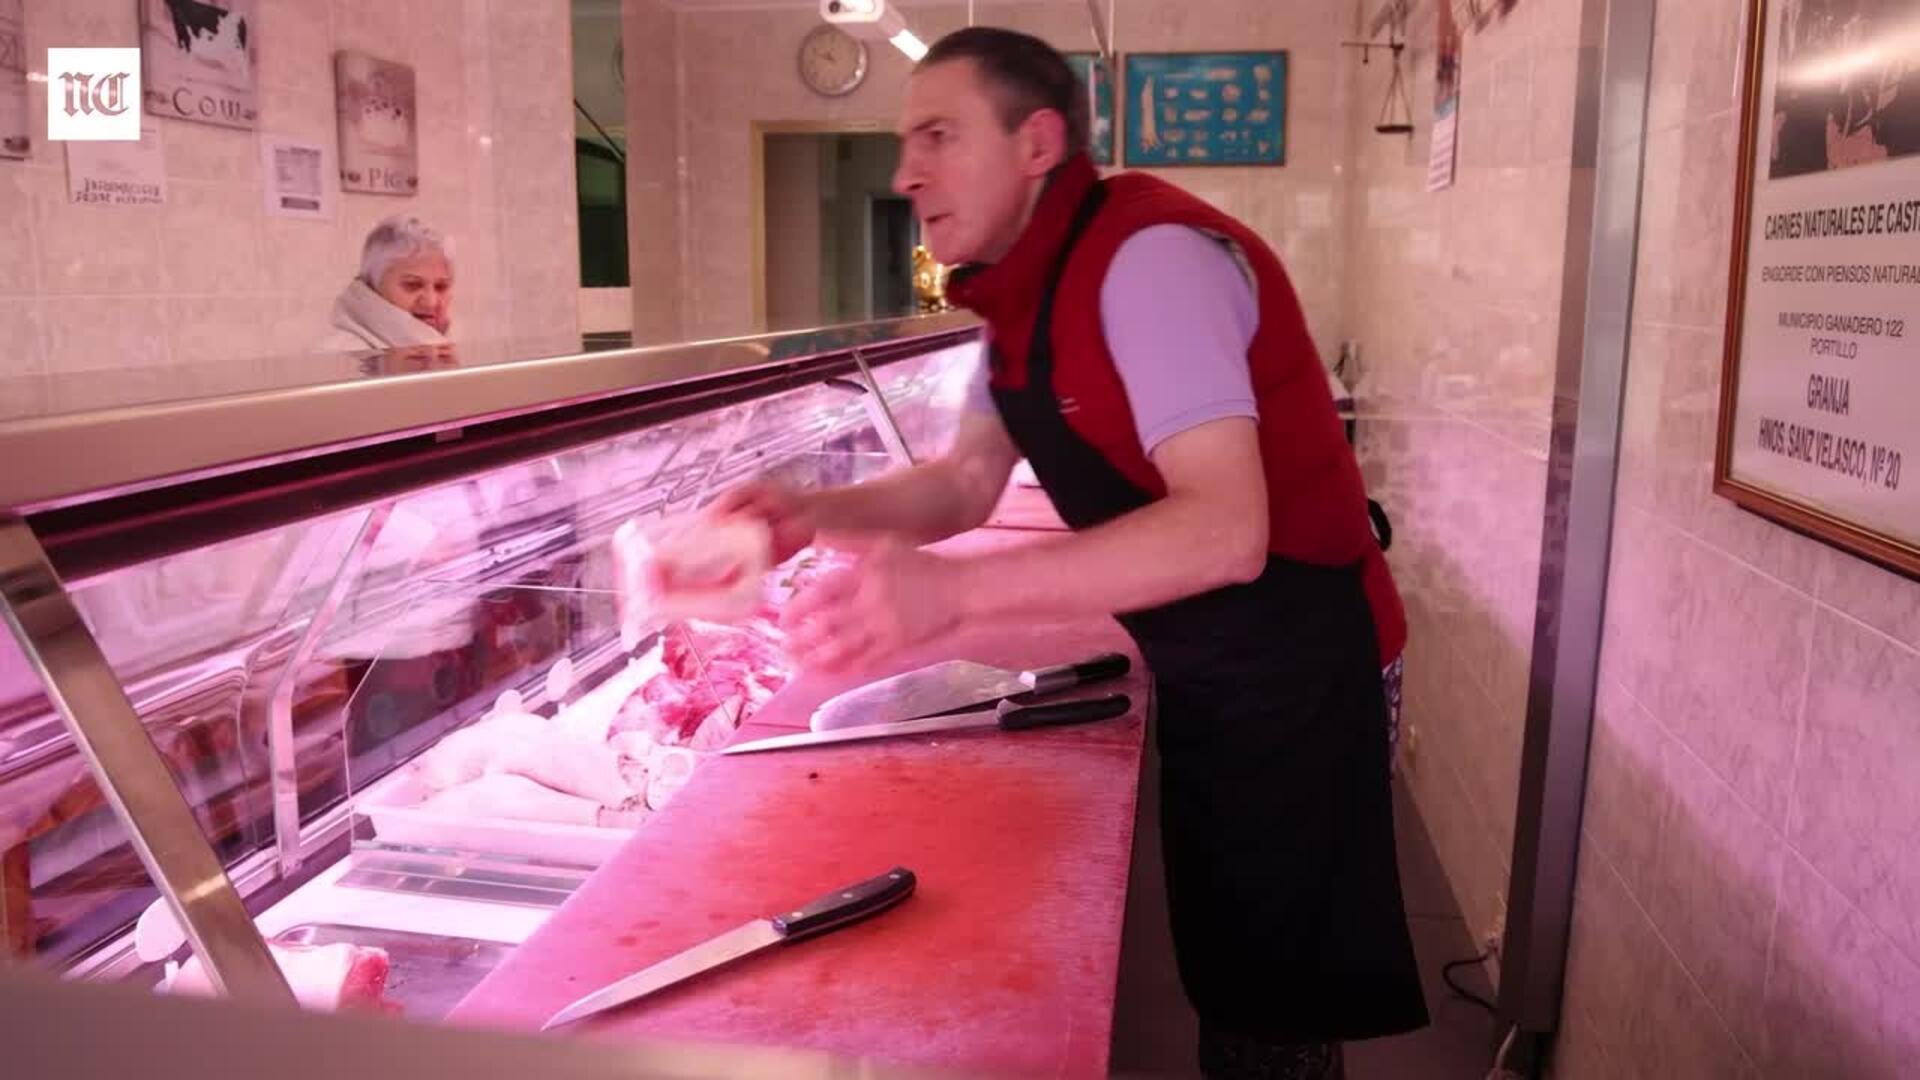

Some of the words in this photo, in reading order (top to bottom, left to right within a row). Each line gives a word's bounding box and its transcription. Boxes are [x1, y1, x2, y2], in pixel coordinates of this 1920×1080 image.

[1765, 211, 1802, 240] CARNES
[1804, 205, 1866, 237] NATURALES
[1867, 203, 1885, 234] DE
[1886, 200, 1920, 233] CAST
[1762, 265, 1803, 283] ENGORDE
[1805, 265, 1825, 283] CON
[1827, 265, 1871, 283] PIENSOS
[1778, 311, 1824, 331] MUNICIPIO
[1825, 314, 1883, 336] GANADERO
[1885, 320, 1905, 338] 122
[1810, 337, 1858, 360] PORTILLO
[1807, 373, 1850, 416] GRANJA
[1787, 423, 1815, 463] SANZ
[1884, 450, 1902, 490] 20
